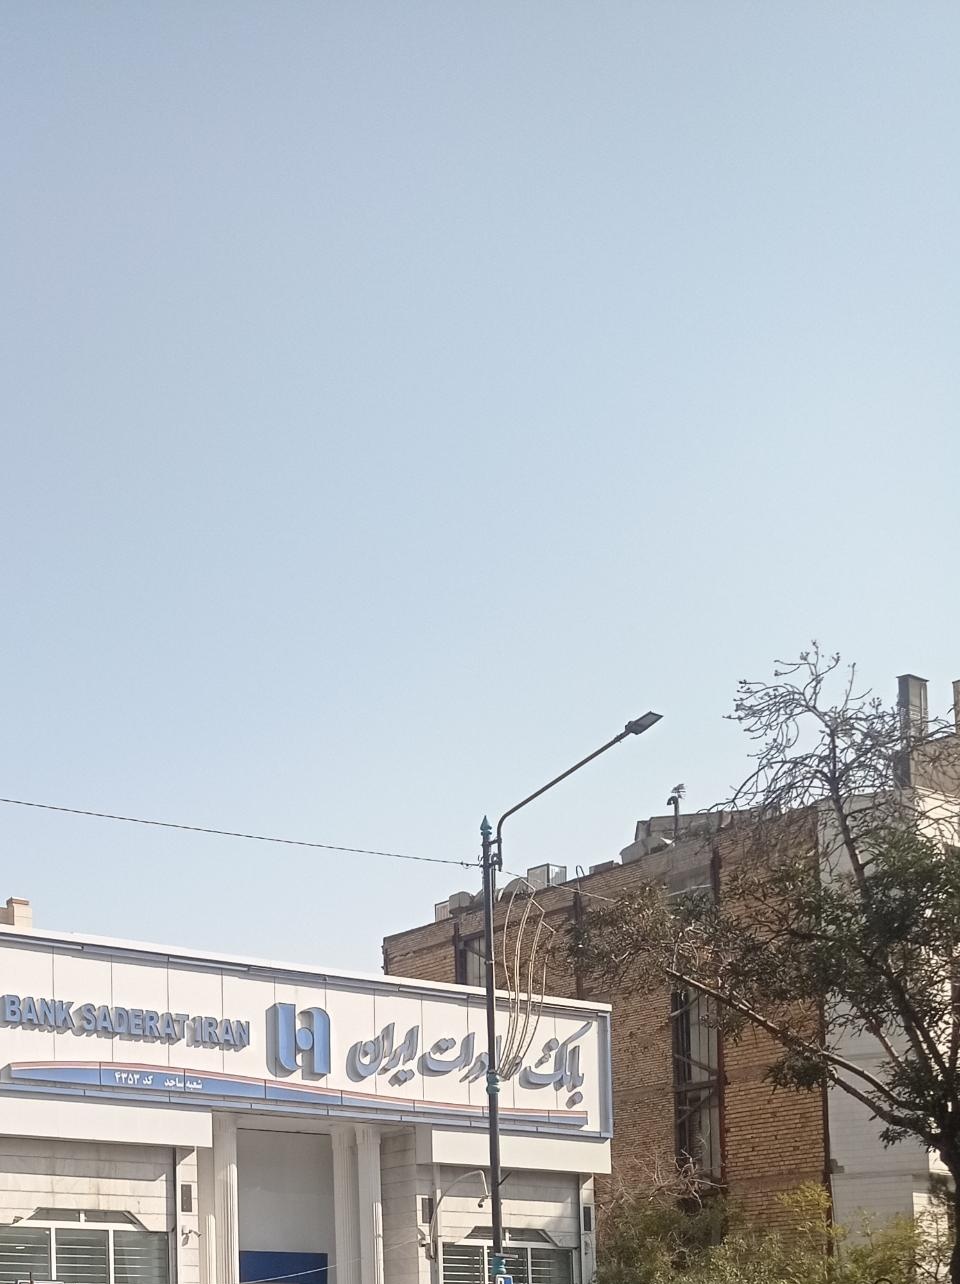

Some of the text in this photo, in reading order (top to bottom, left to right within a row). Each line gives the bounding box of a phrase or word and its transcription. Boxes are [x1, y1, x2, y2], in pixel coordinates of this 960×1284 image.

[2, 994, 250, 1051] BANK SADERAT IRAN
[142, 1075, 154, 1085] کد
[346, 1021, 419, 1087] ایران
[518, 1020, 593, 1109] بانک
[185, 1079, 203, 1091] شعبه
